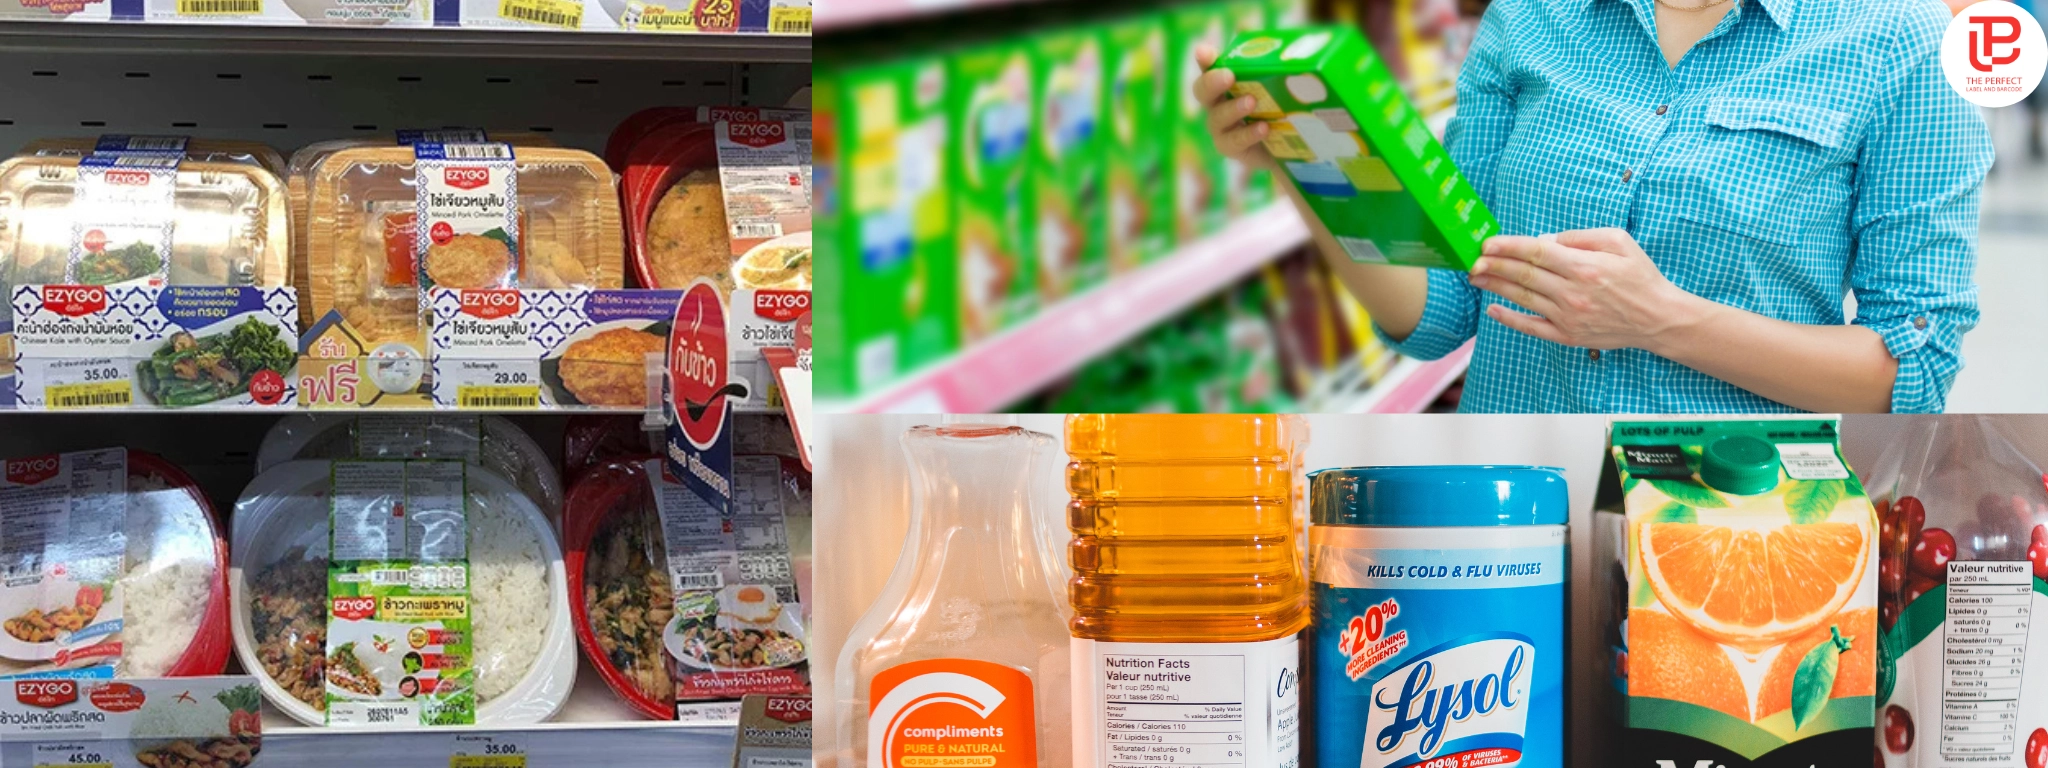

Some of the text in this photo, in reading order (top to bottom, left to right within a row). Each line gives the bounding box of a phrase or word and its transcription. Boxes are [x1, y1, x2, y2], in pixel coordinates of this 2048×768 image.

[711, 110, 757, 121] EZYGO
[731, 124, 781, 136] EZYGO
[108, 174, 149, 185] EZYGO
[446, 170, 487, 180] EZYGO
[430, 193, 504, 211] ไข่เจียวหมูสับ
[45, 290, 102, 303] EZYGO
[463, 293, 517, 306] EZYGO
[757, 295, 809, 308] EZYGO
[453, 320, 528, 339] ไข่เจียวหมูสับ
[675, 337, 717, 388] กับข้าว
[85, 368, 119, 380] 35.00
[495, 372, 528, 384] 29.00
[301, 360, 359, 402] ฟรี
[1621, 426, 1704, 436] LOTS OF PULP
[9, 458, 58, 475] EZYGO
[1367, 563, 1542, 578] KILLS COLD & FLU VIRUSES
[1950, 564, 2024, 573] Valeur nutritive
[334, 600, 375, 611] EZYGO
[384, 597, 465, 614] ข้าวกะเพราหมู
[1340, 599, 1398, 657] +20%
[1347, 631, 1406, 674] MORE CLEANING
[1106, 658, 1190, 669] Nutrition Facts
[1106, 671, 1192, 682] Valeur nutritive
[19, 683, 73, 695] EZYGO
[1140, 684, 1155, 692] (250
[1156, 685, 1170, 693] mL)
[1150, 694, 1165, 702] (250
[1166, 694, 1180, 702] mL)
[1375, 645, 1524, 756] Lysol
[1107, 722, 1136, 730] Calories
[903, 725, 1004, 741] compliments
[1124, 734, 1150, 742] Lipides
[485, 745, 516, 754] 35.00
[903, 743, 1006, 754] PURE & NATURAL
[1473, 750, 1502, 759] VIRUSES
[69, 753, 101, 764] 45.00
[904, 758, 993, 766] NO PULP SANS PULPE
